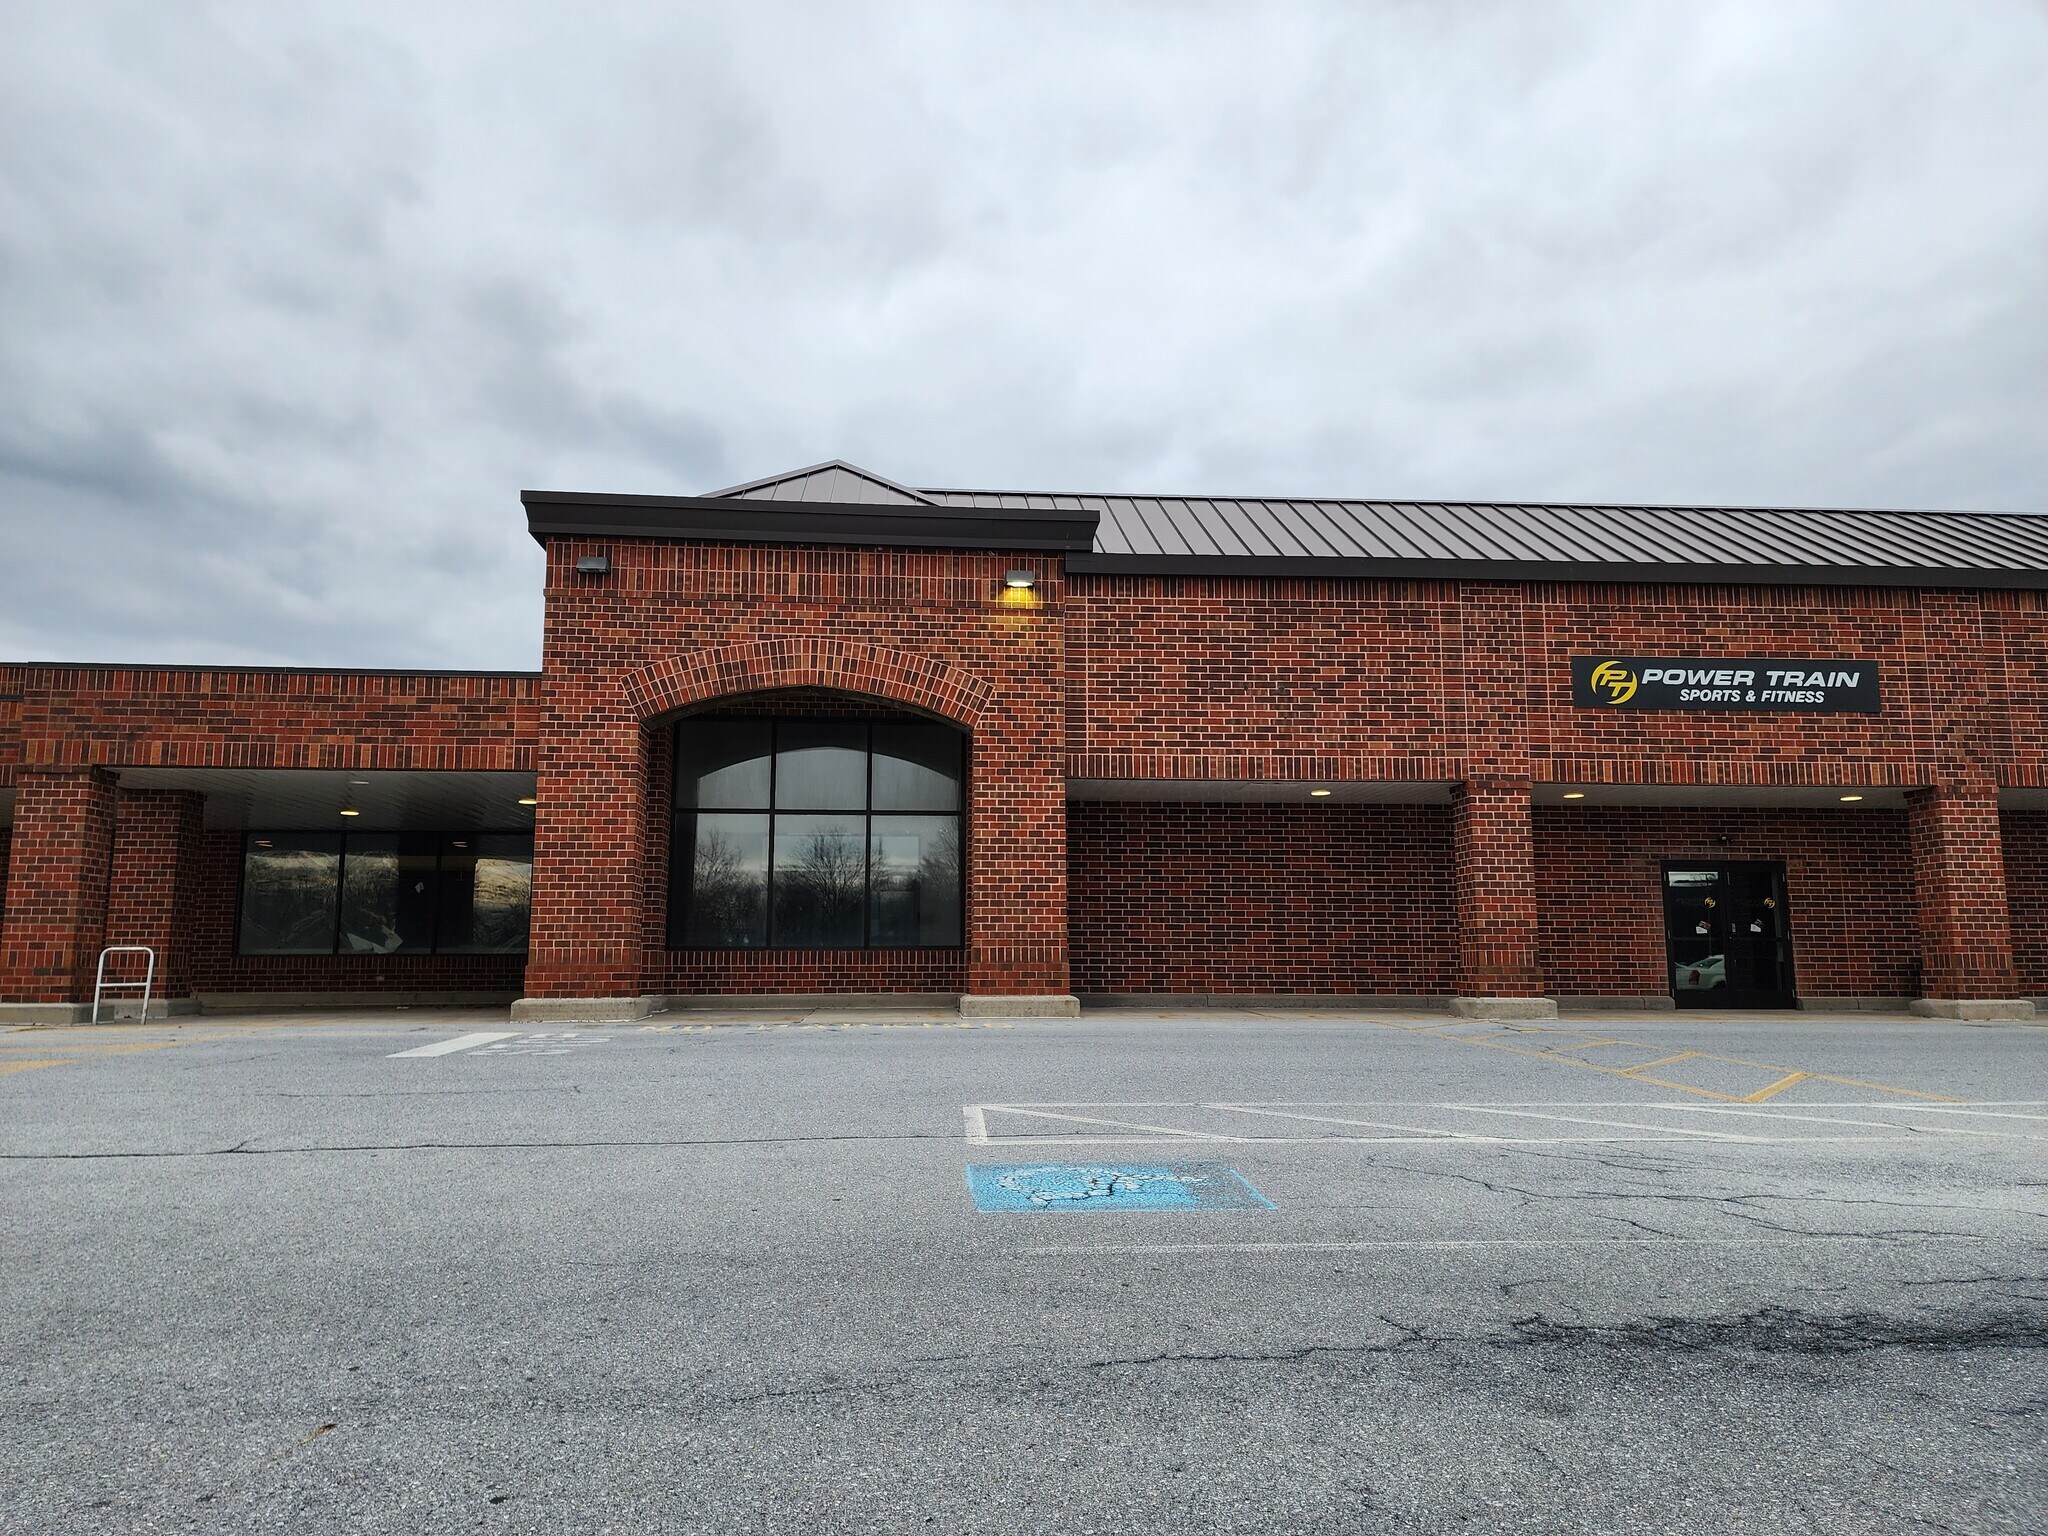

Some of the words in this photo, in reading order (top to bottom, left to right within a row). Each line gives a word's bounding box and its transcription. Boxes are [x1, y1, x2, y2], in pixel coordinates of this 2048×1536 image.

[1641, 669, 1755, 686] POWER
[1766, 671, 1860, 688] TRAIN
[1680, 689, 1741, 702] SPORTS
[1745, 690, 1756, 702] &
[1761, 690, 1825, 703] FITNESS
